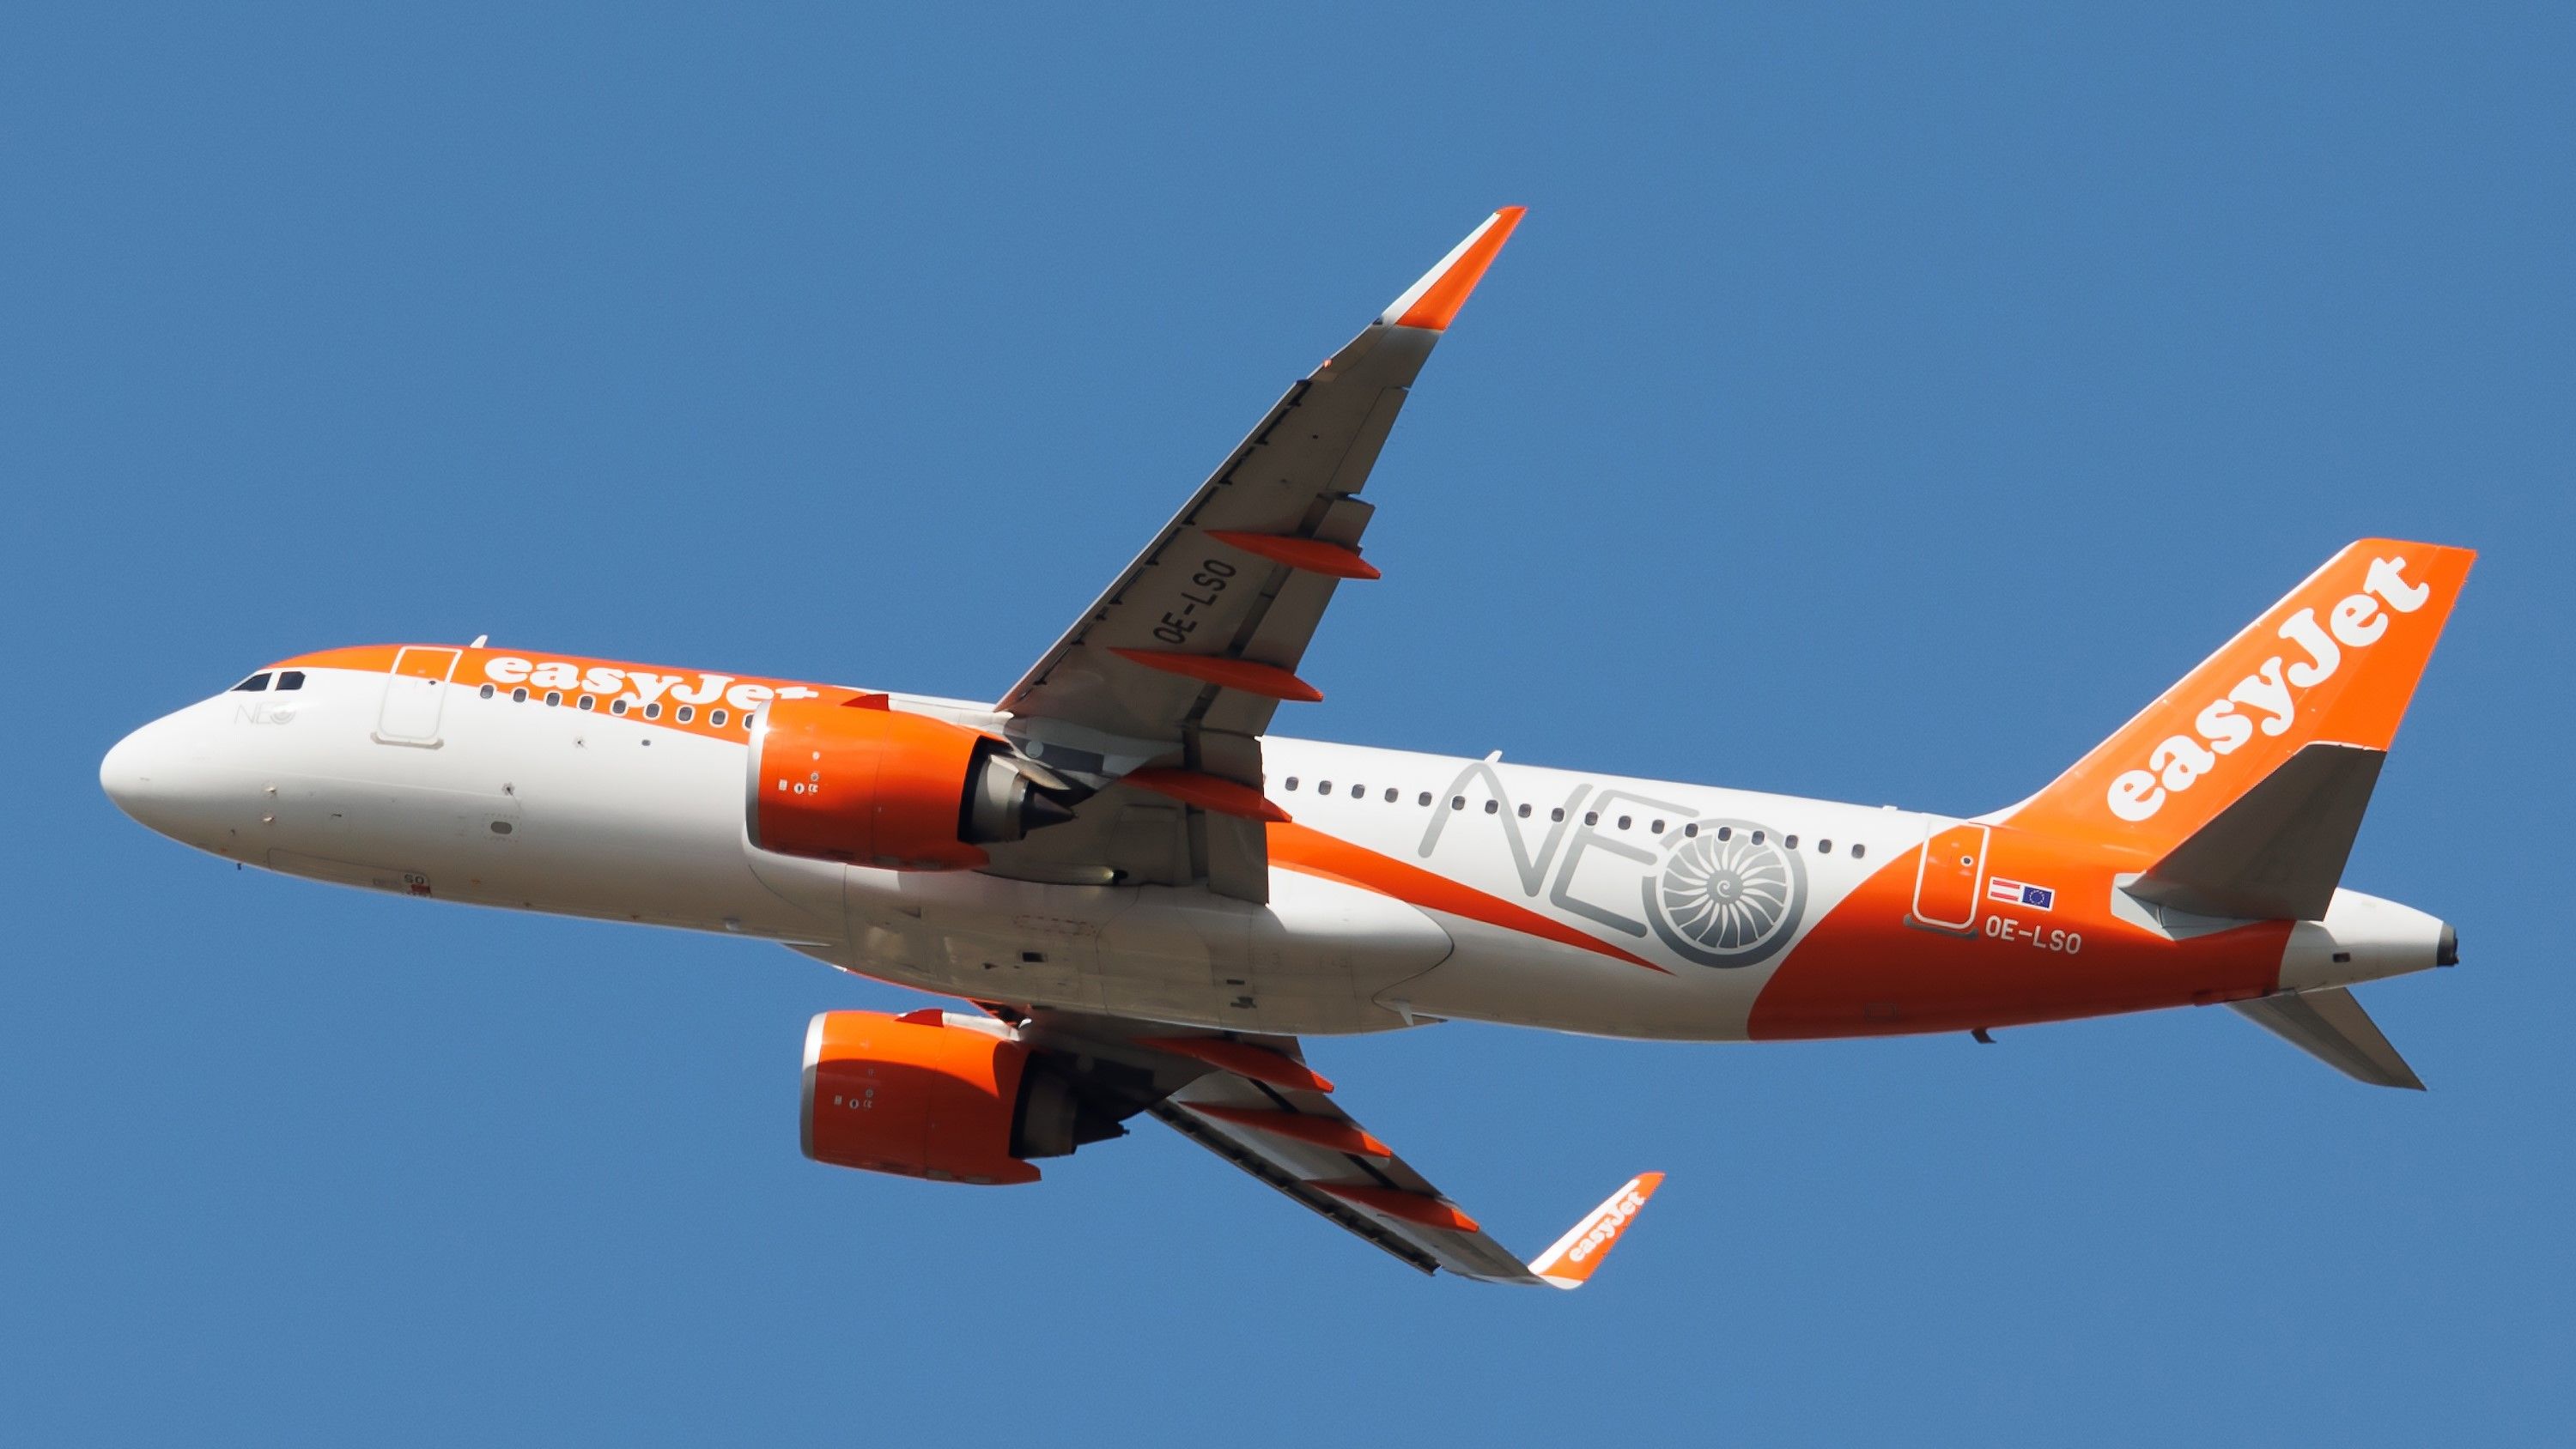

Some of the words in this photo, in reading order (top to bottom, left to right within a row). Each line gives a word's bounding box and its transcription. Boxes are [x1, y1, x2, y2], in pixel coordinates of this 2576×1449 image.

[1153, 559, 1236, 644] OE-LSO
[2107, 556, 2429, 822] easyJet
[1418, 762, 1808, 969] NEO
[1985, 915, 2081, 955] OE-LSO
[1569, 1191, 1645, 1262] easyJet
